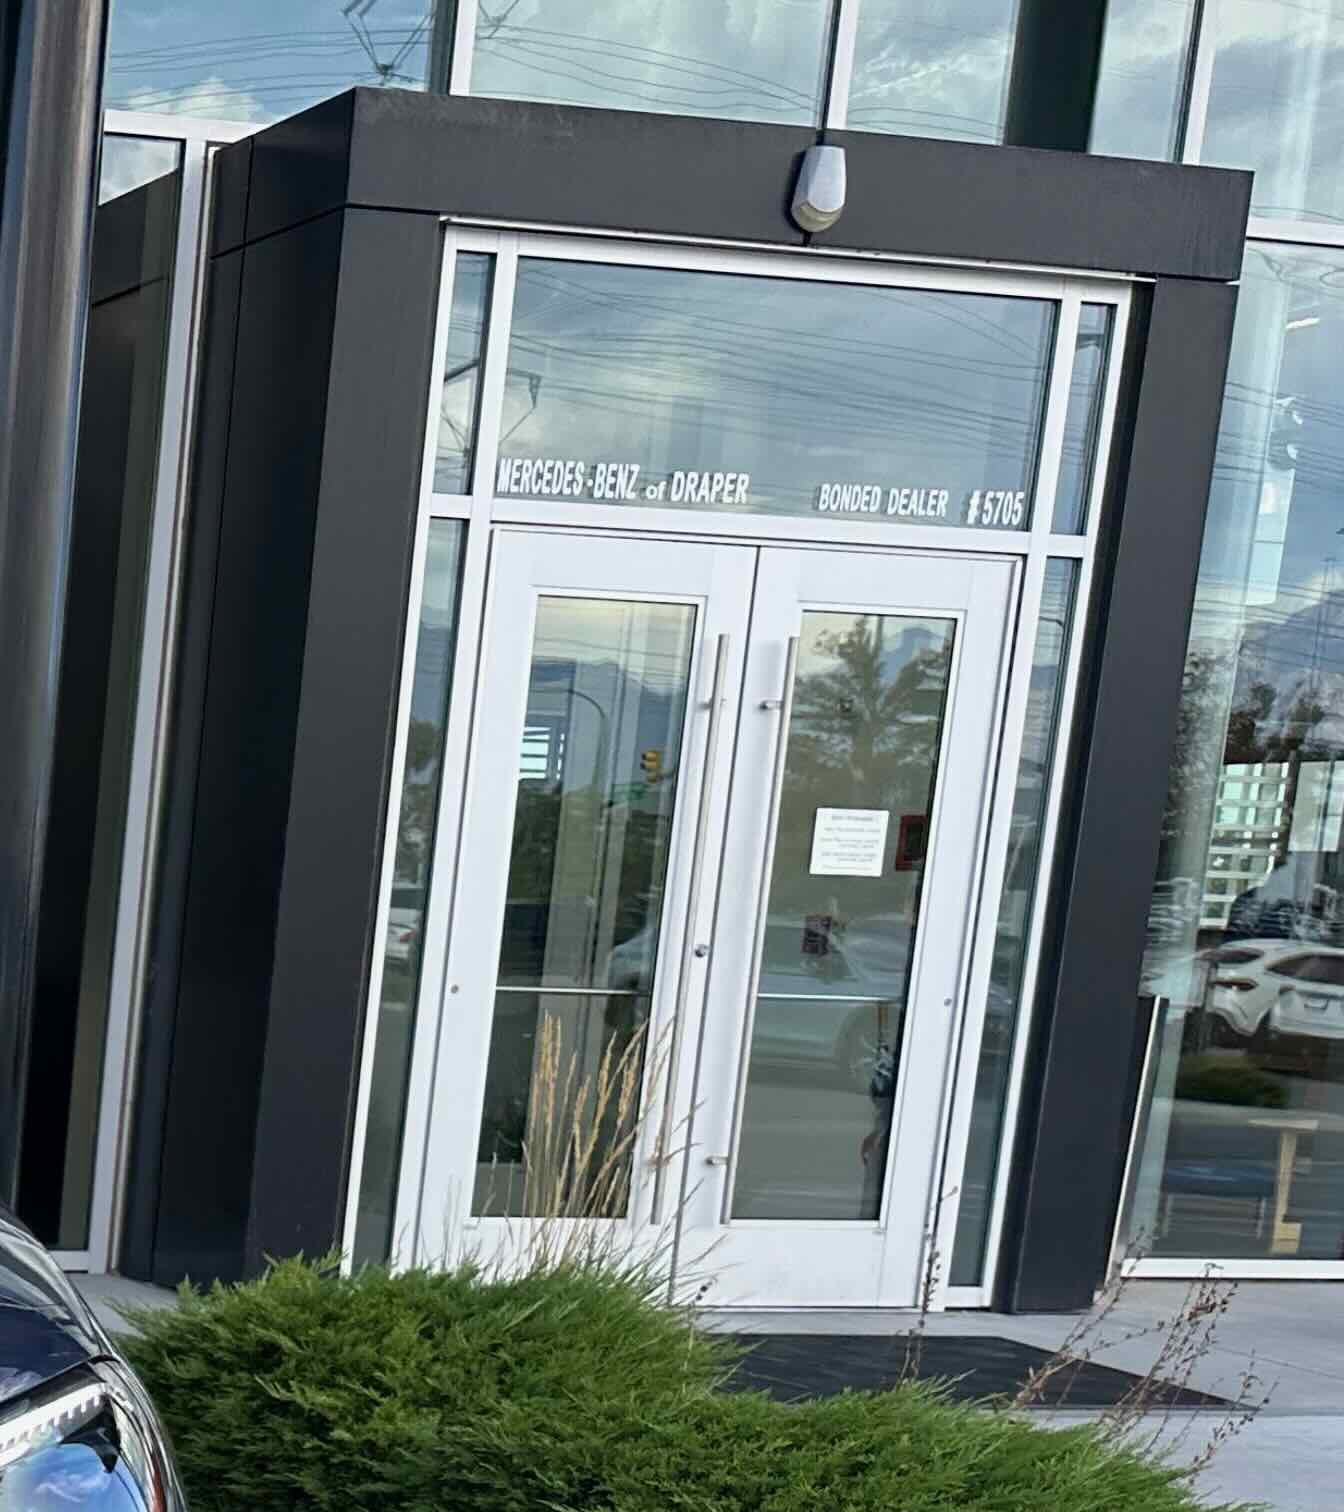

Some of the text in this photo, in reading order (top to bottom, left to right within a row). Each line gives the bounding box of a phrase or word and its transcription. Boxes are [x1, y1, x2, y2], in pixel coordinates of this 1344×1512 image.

[497, 456, 749, 504] MERCEDES-BENZ of DRAPER
[818, 483, 881, 513] BONDED
[887, 488, 949, 517] DEALER
